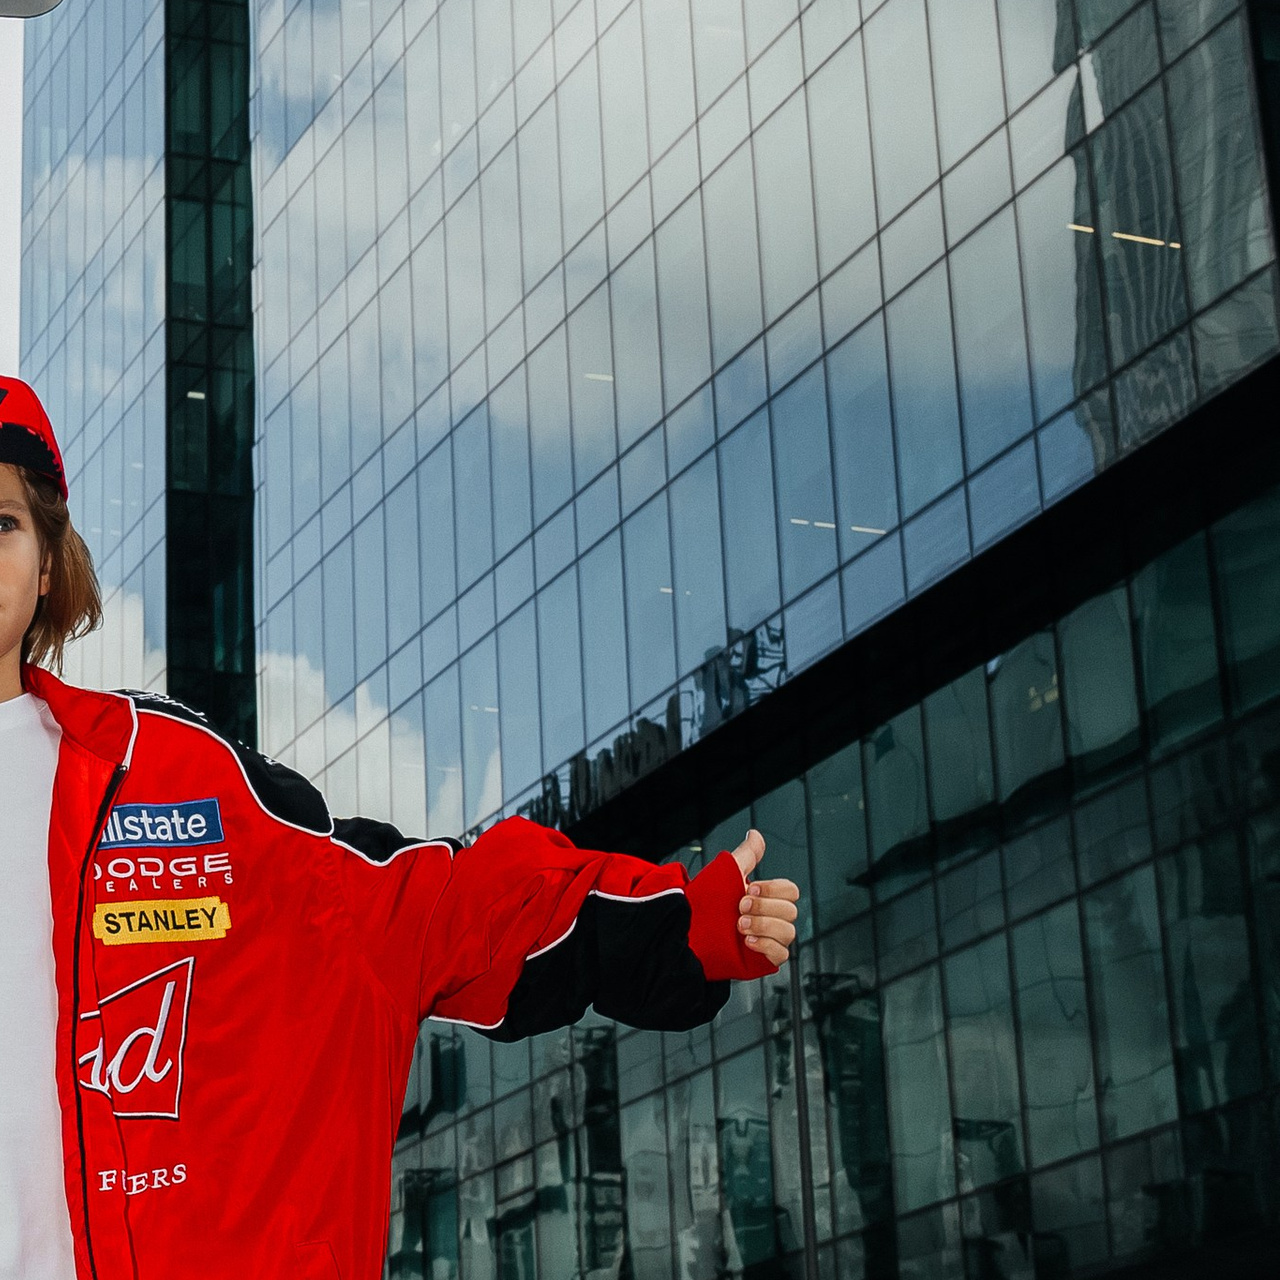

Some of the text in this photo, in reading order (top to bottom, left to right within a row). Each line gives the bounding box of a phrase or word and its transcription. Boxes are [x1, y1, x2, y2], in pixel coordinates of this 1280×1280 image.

[101, 809, 208, 843] llstate
[105, 871, 234, 893] EALERS
[104, 906, 217, 934] STANLEY
